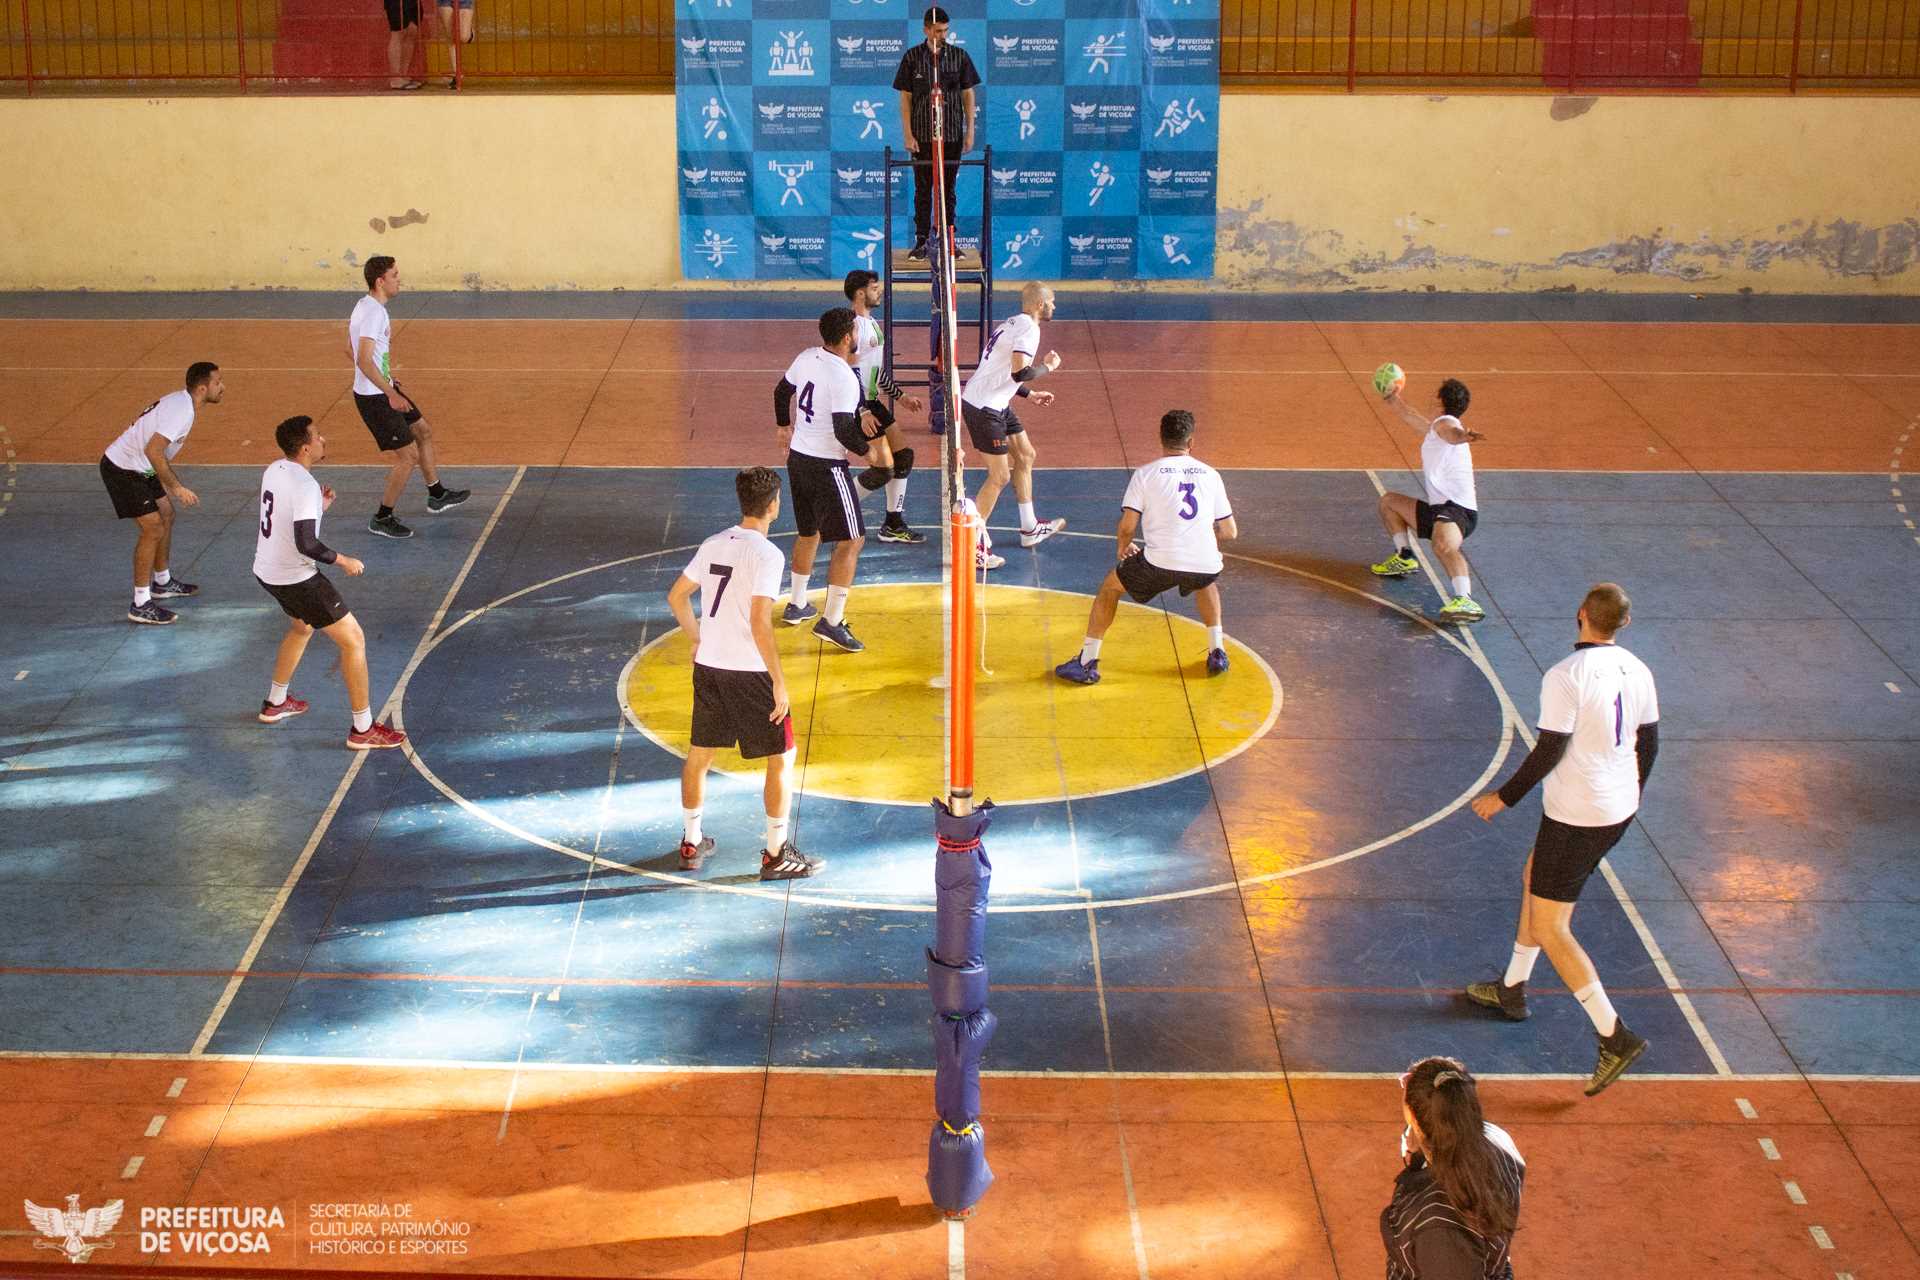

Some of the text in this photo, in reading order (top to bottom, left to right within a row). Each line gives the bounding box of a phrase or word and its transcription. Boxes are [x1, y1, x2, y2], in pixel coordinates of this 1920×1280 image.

[798, 380, 815, 424] 4
[261, 490, 274, 539] 3
[1178, 481, 1199, 521] 3
[709, 562, 734, 618] 7
[1613, 690, 1623, 748] 1
